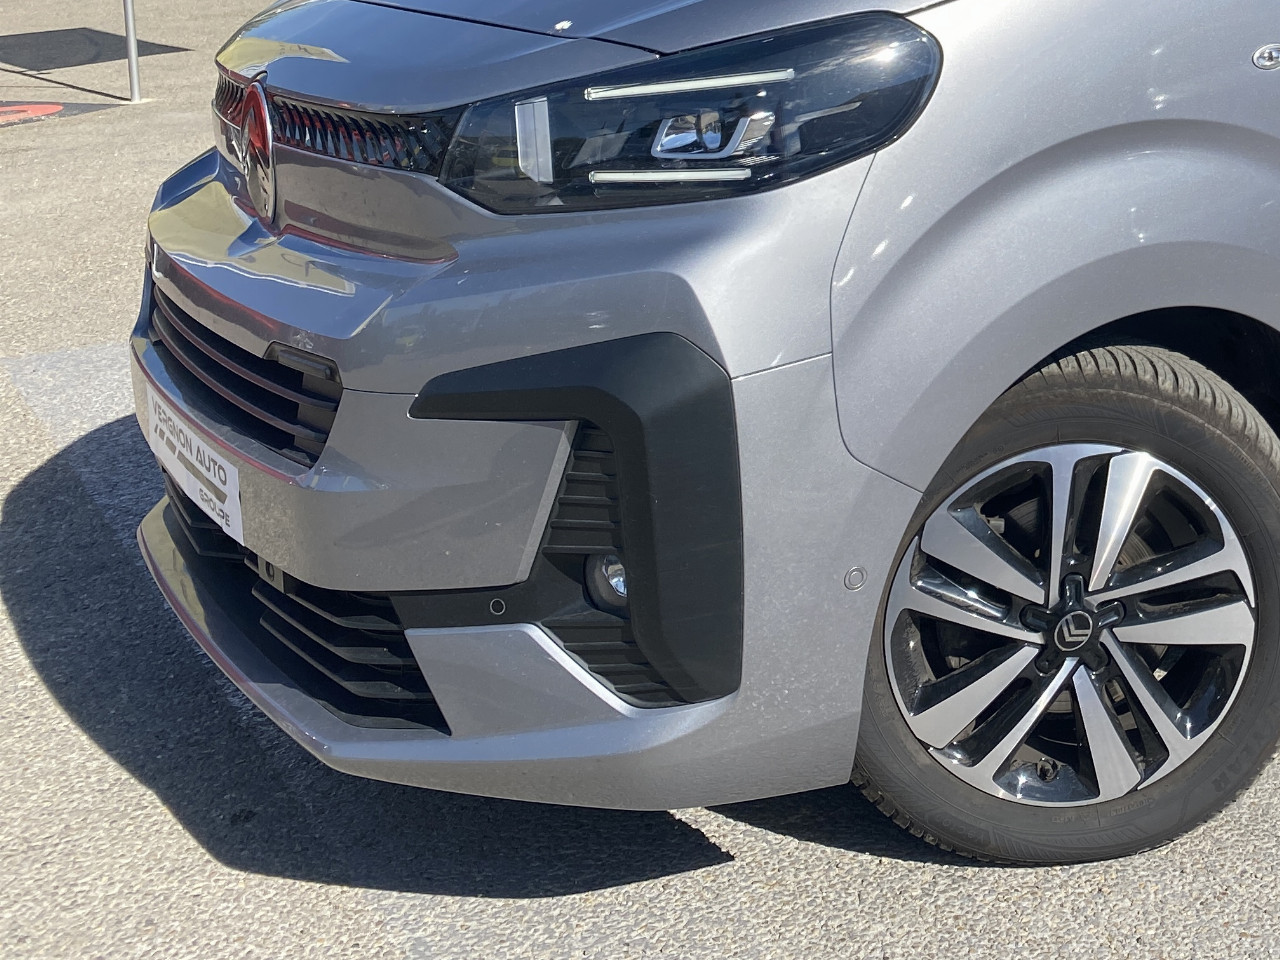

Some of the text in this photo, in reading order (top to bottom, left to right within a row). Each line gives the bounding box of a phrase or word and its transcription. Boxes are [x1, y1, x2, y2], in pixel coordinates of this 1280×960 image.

[151, 396, 228, 487] VERGNON AUTO
[199, 487, 231, 528] GROUPE
